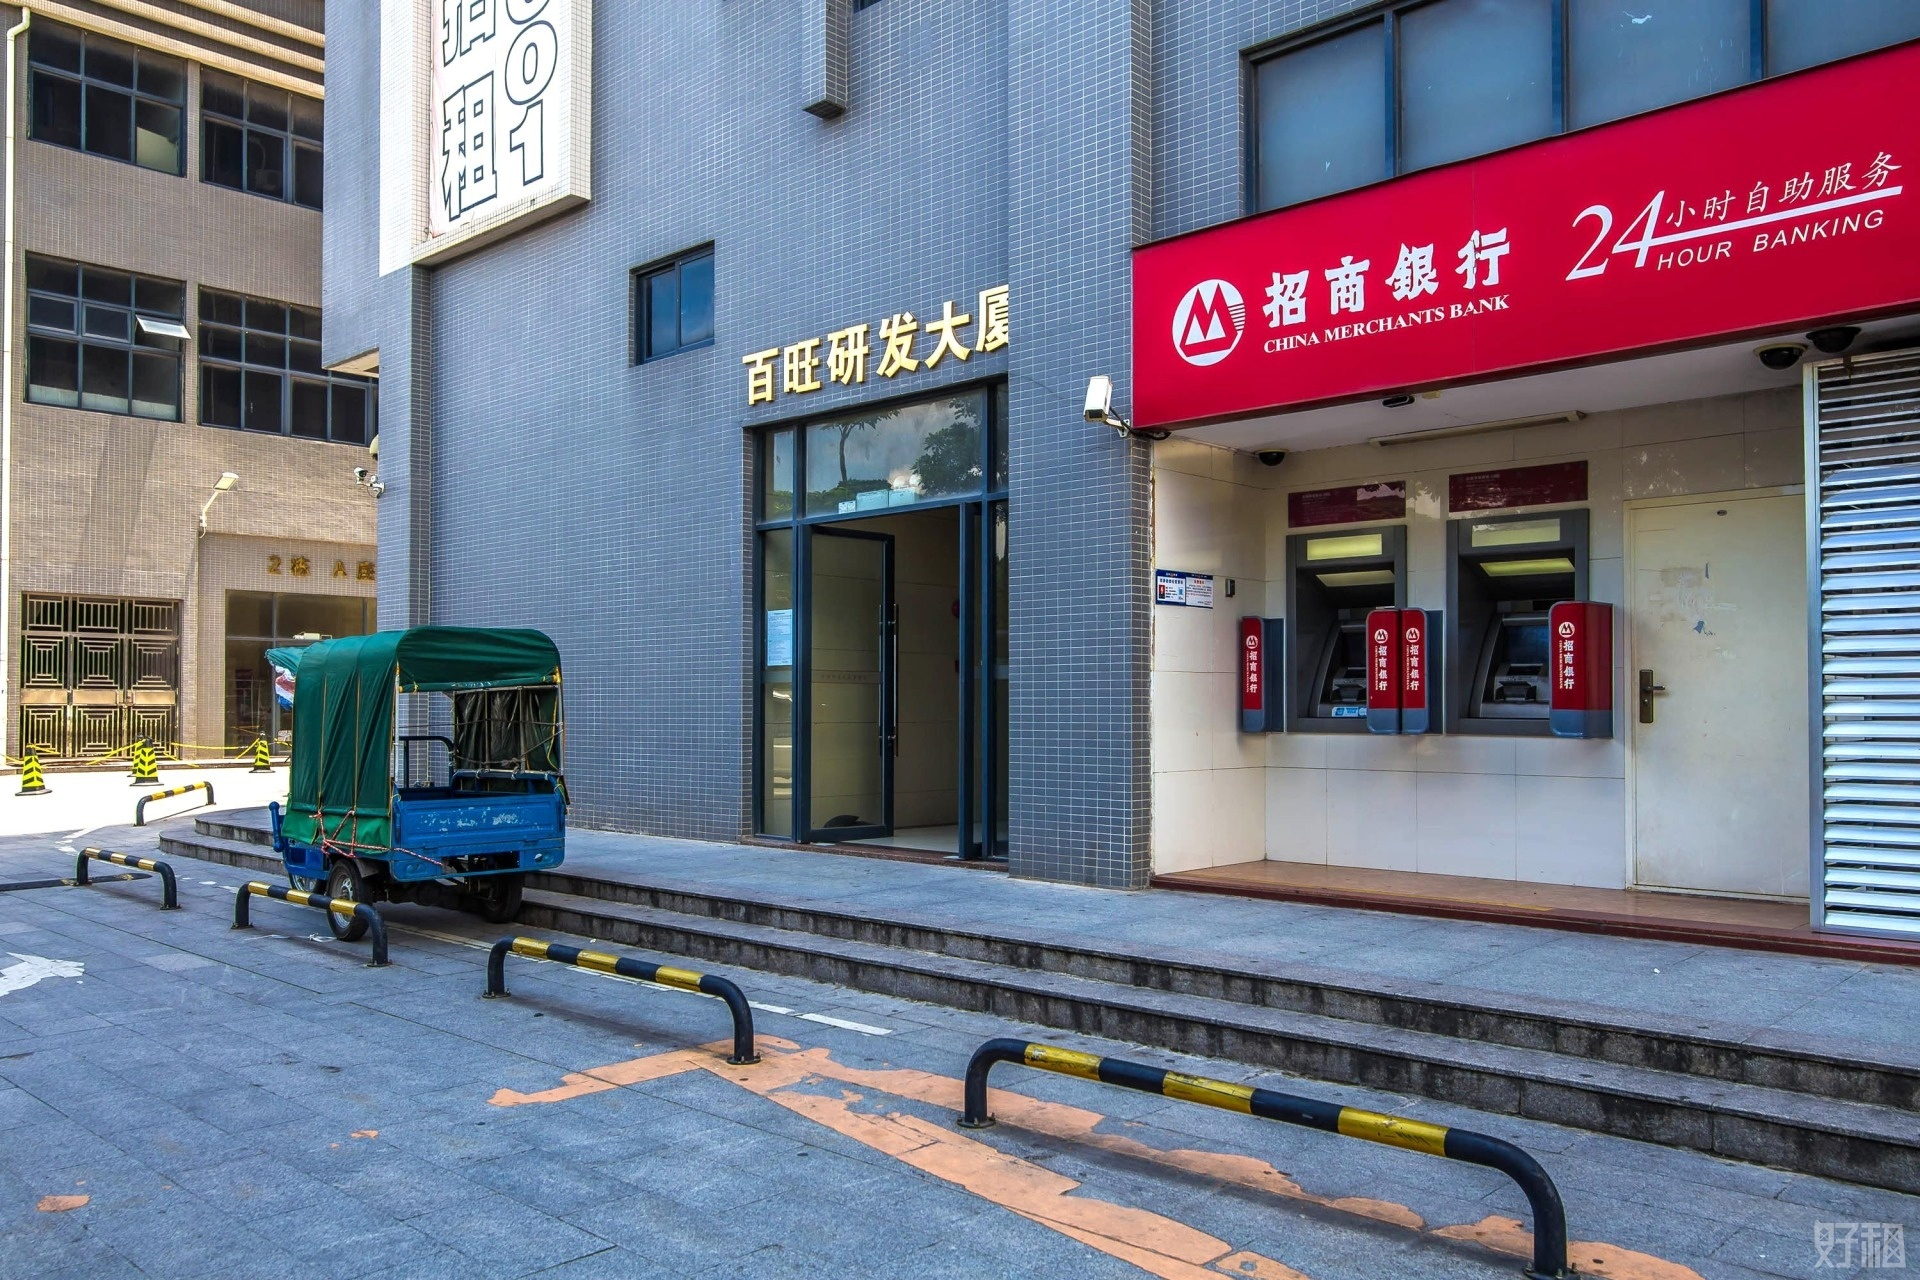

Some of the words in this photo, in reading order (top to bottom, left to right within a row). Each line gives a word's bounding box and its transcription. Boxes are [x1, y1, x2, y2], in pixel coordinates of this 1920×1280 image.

[504, 0, 558, 187] 01
[1565, 190, 1665, 282] 24
[1666, 151, 1902, 228] 小时自助服务
[1657, 241, 1733, 271] HOUR
[1753, 209, 1885, 252] BANKING
[1262, 227, 1510, 328] 招商銀行
[1263, 332, 1321, 354] CHINA
[1324, 307, 1446, 344] MERCHANTS
[1449, 294, 1510, 319] BANK
[742, 284, 1009, 406] 百旺研发大厦
